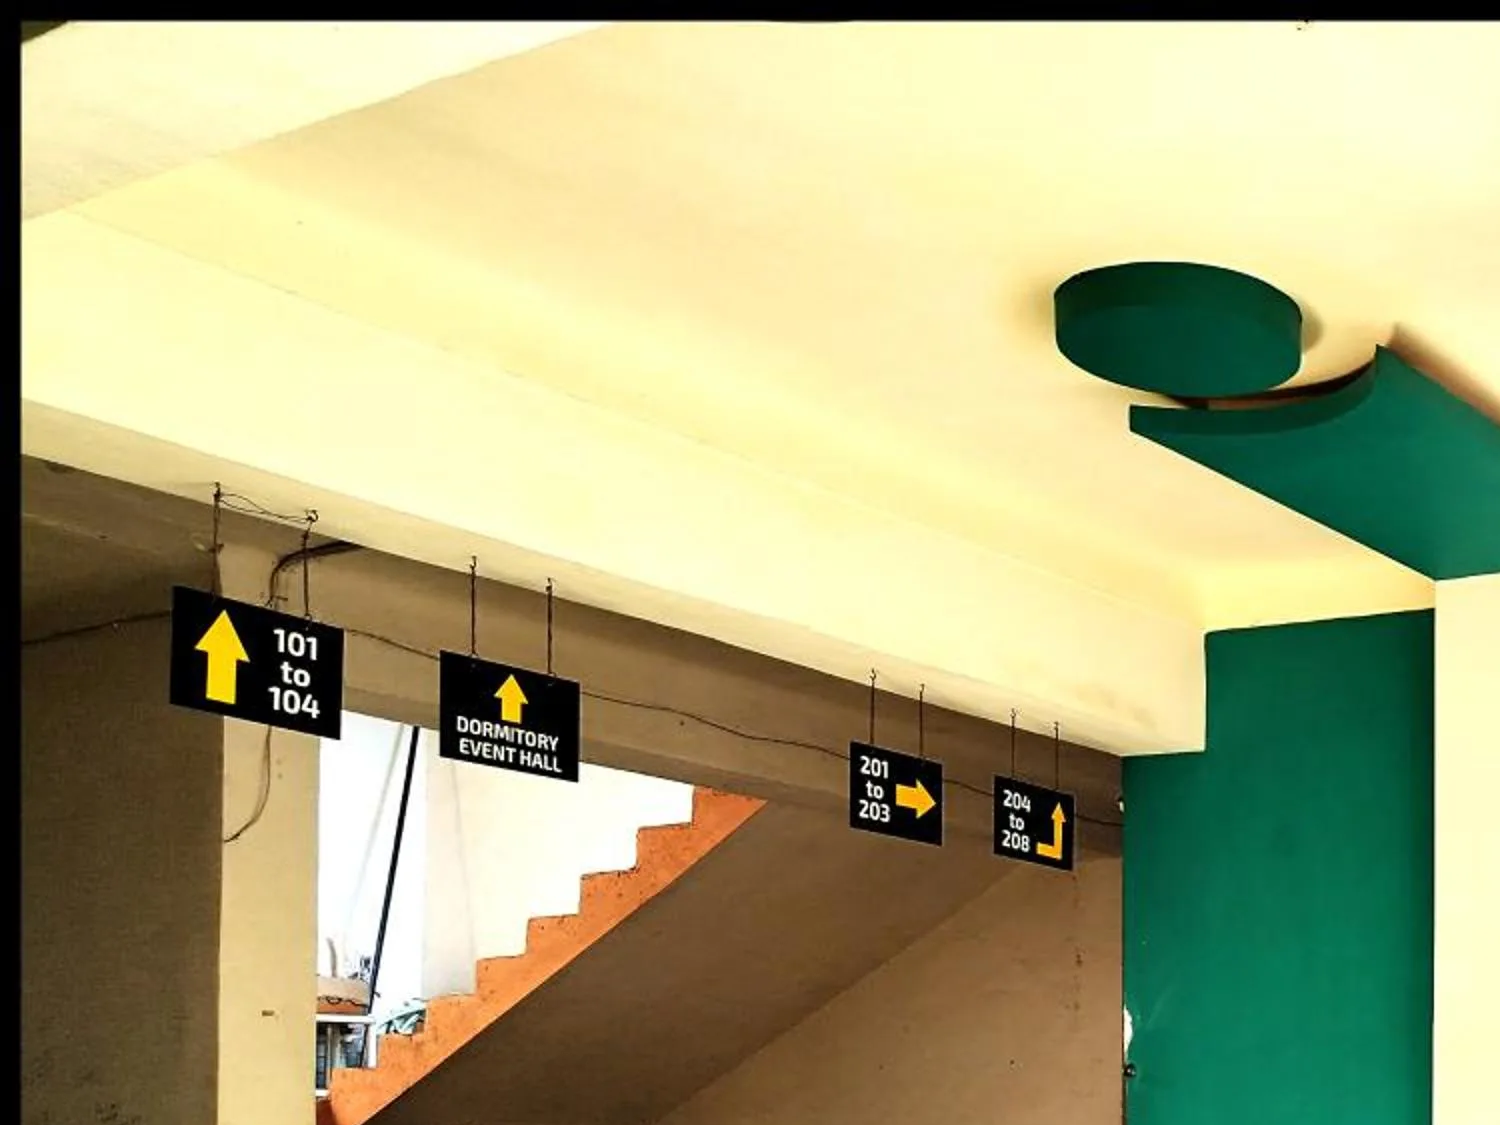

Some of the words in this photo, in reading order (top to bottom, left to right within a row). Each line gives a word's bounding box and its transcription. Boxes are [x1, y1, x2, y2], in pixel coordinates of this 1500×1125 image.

[273, 628, 317, 661] 101
[281, 662, 311, 688] to
[268, 687, 320, 719] 104
[456, 716, 559, 752] DORMITORY
[459, 738, 516, 764] EVENT
[520, 749, 562, 773] HALL
[860, 755, 889, 779] 201
[866, 780, 884, 799] to
[1003, 790, 1031, 813] 204
[859, 800, 890, 823] 203
[1009, 813, 1025, 831] to
[1002, 830, 1030, 853] 208
